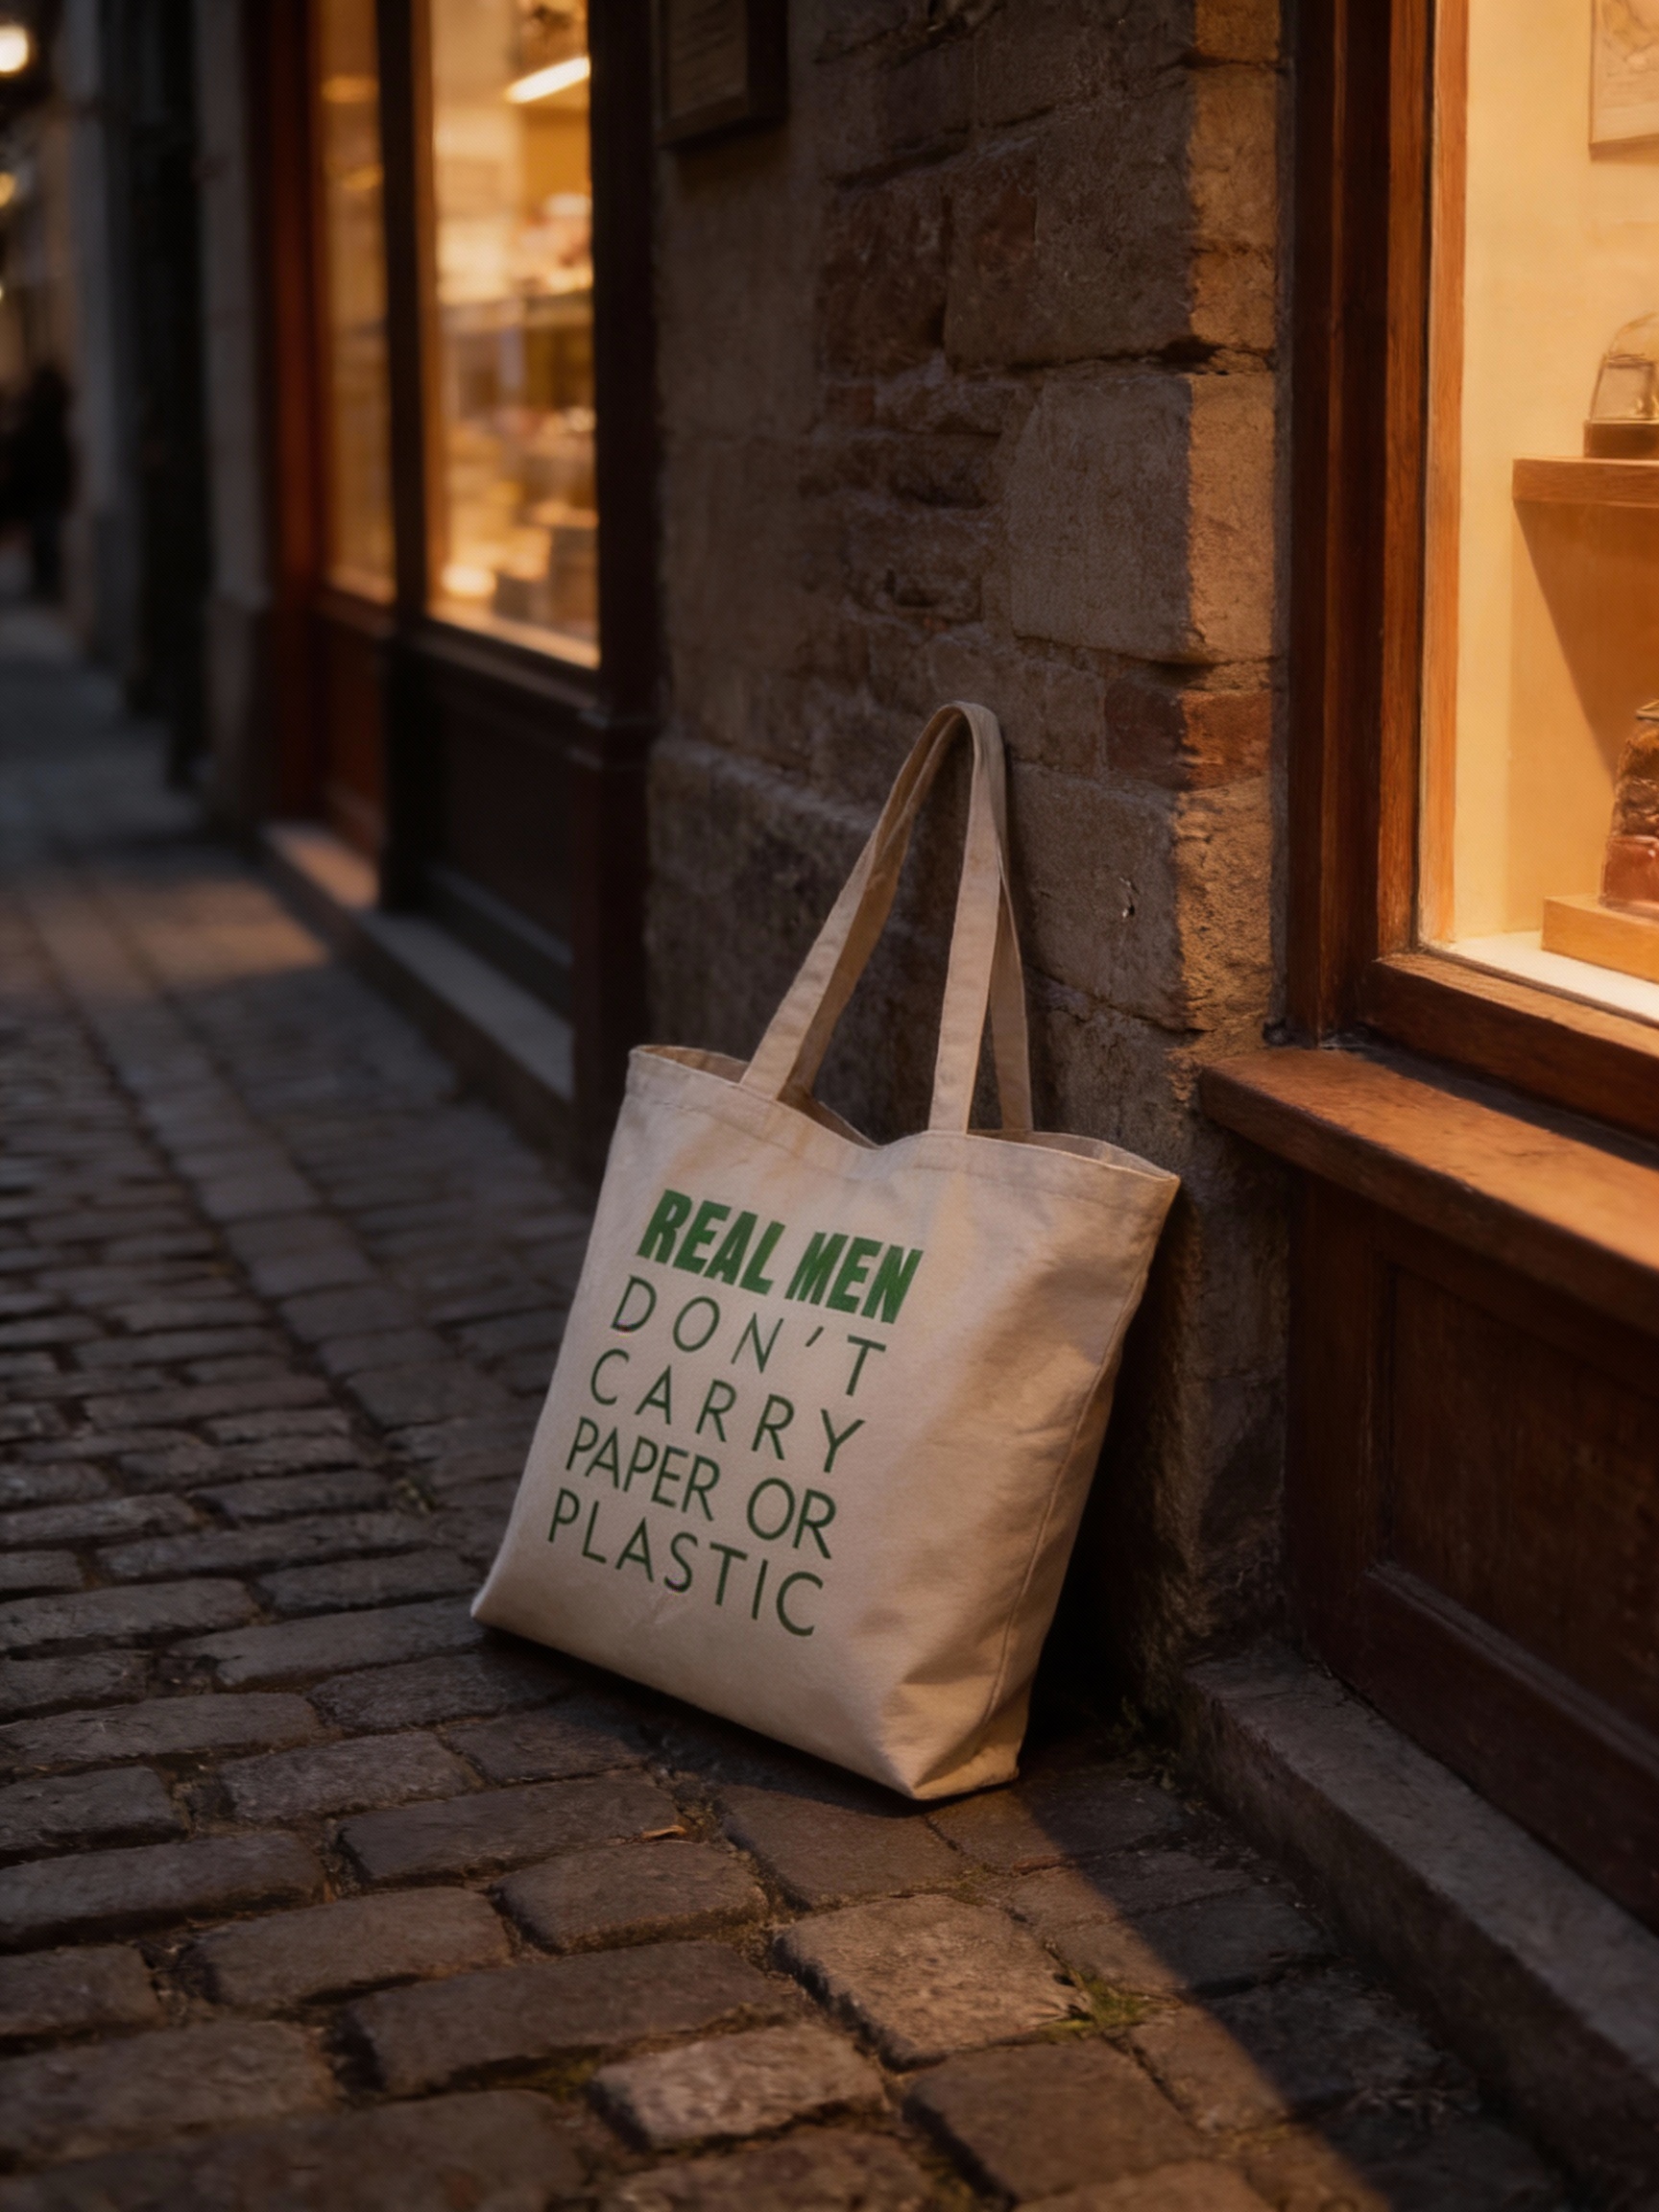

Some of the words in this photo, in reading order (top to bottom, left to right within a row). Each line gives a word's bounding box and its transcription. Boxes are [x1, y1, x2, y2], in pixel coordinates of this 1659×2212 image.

[636, 1189, 786, 1296] REAL
[783, 1232, 925, 1325] MEN
[611, 1274, 887, 1397] DON'T
[589, 1348, 866, 1474] CARRY
[565, 1416, 721, 1523] PAPER
[746, 1478, 837, 1560] OR
[547, 1487, 824, 1638] PLASTIC
